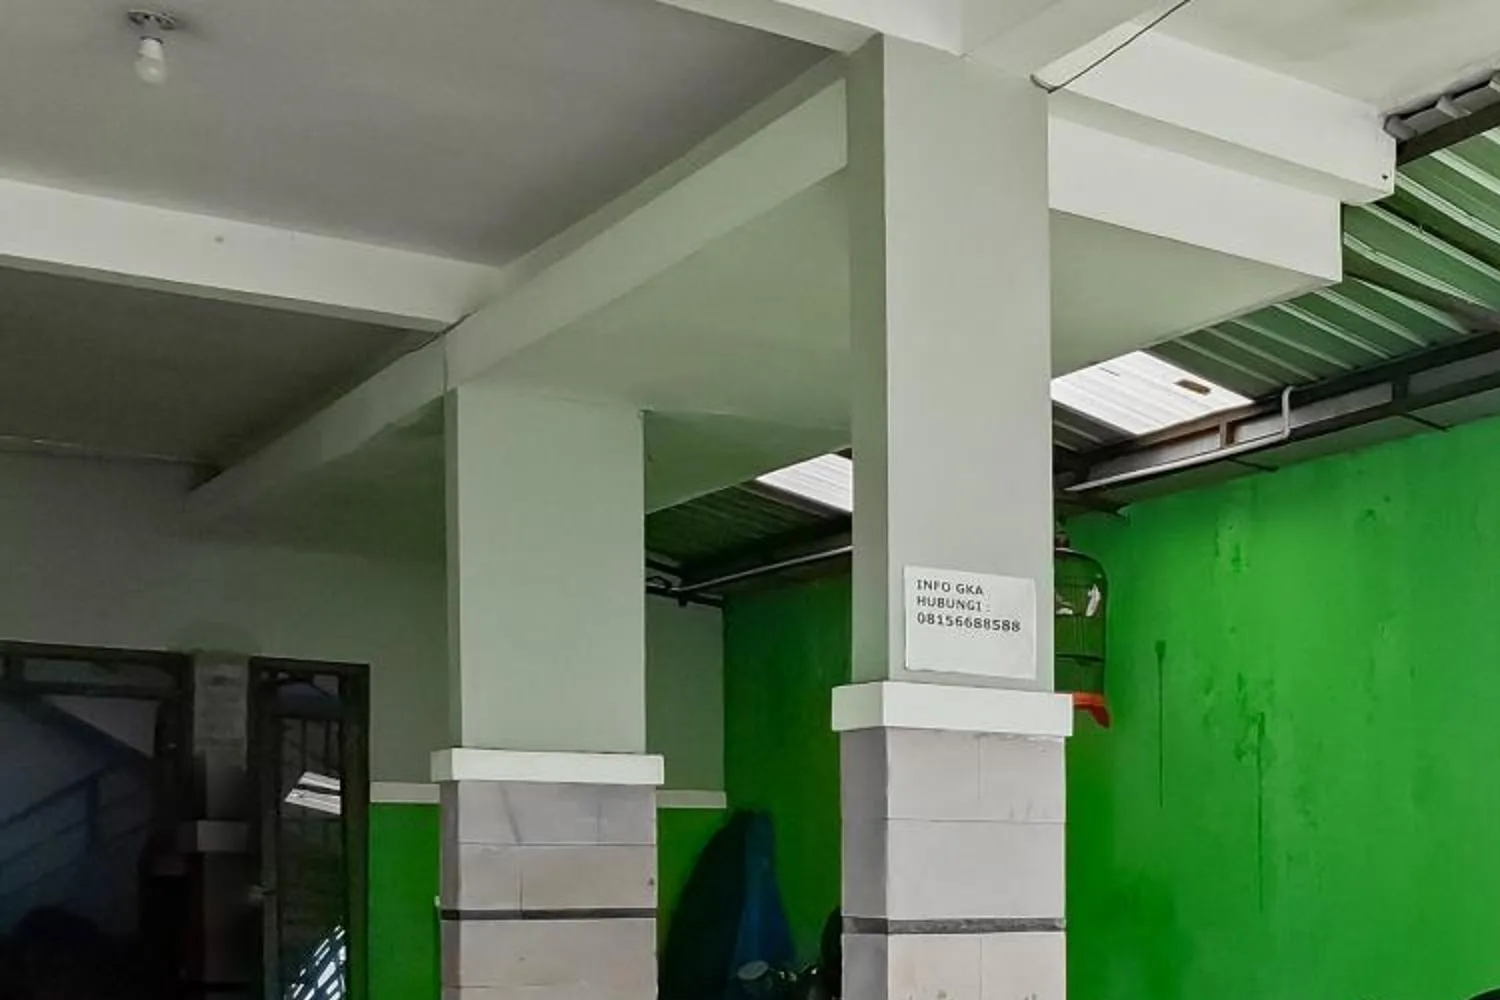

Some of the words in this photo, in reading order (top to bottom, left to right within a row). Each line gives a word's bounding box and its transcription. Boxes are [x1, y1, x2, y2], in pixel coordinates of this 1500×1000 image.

[916, 579, 951, 593] INFO
[955, 583, 984, 595] GKA
[916, 596, 982, 612] HUBUNGI
